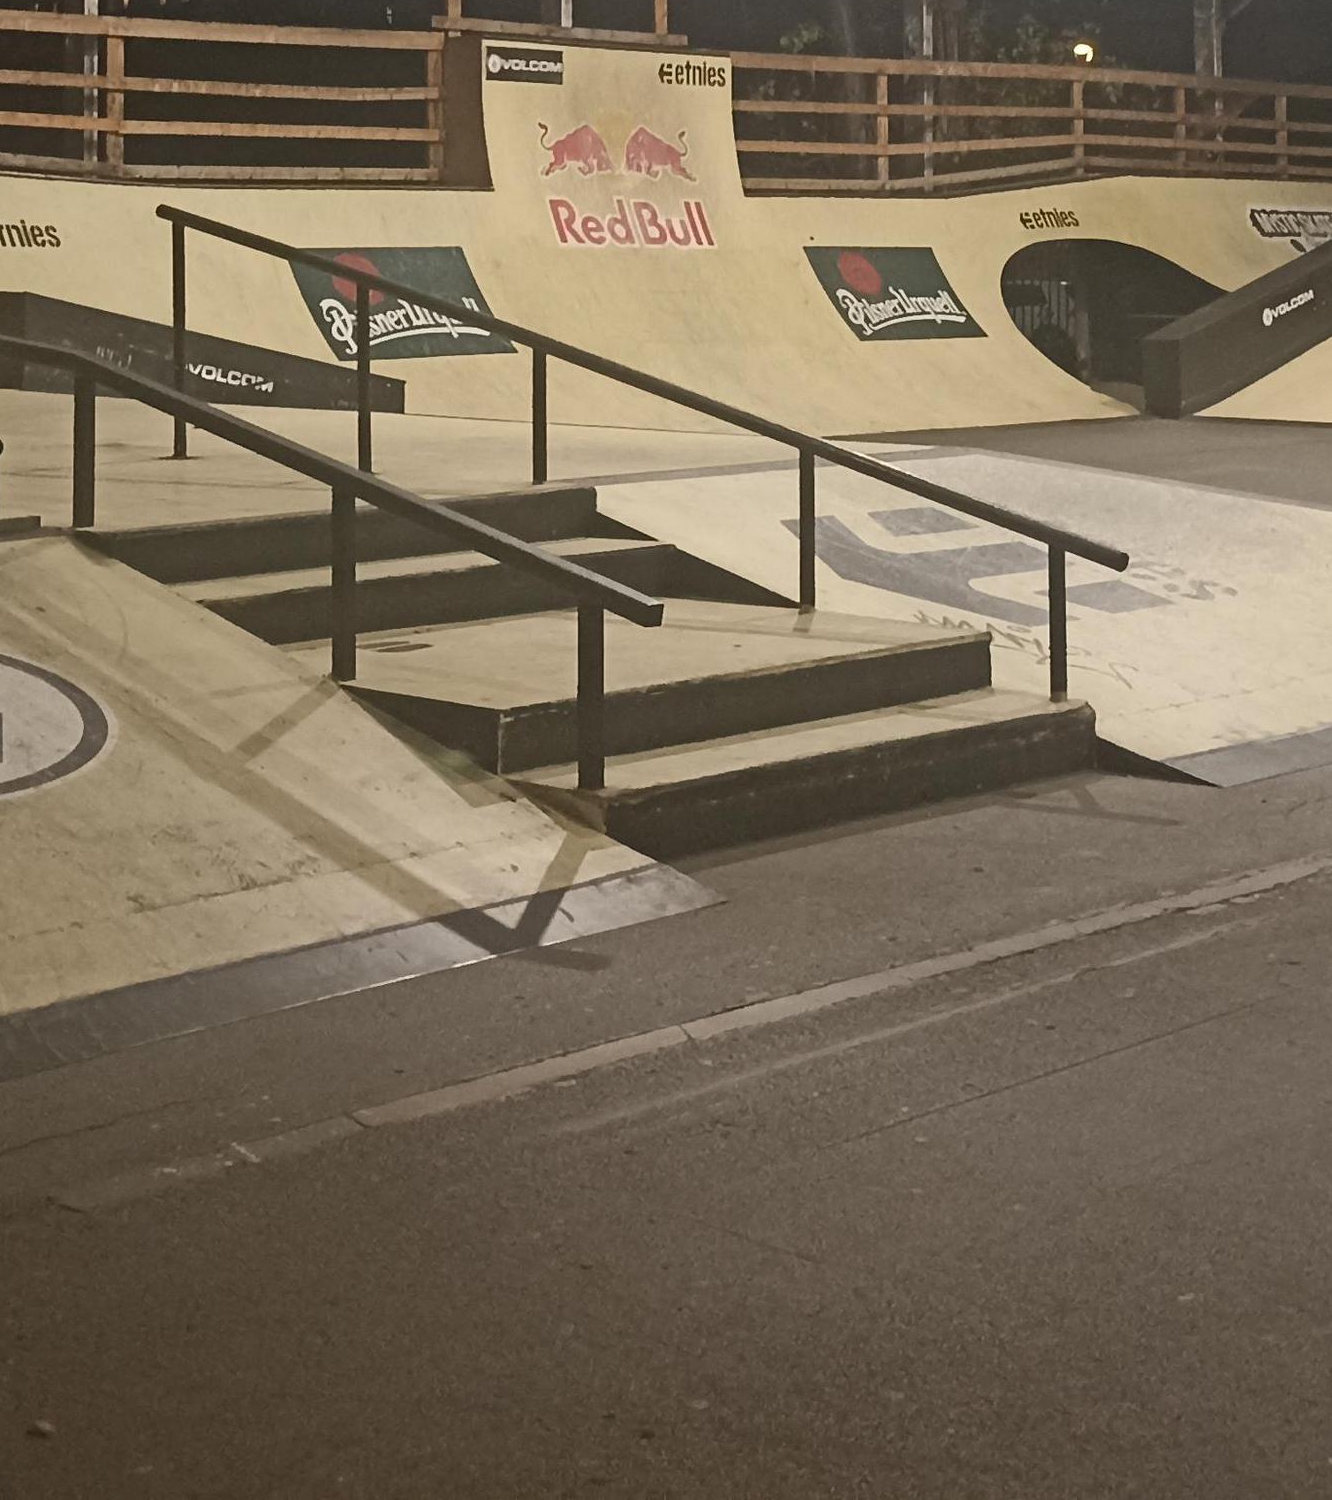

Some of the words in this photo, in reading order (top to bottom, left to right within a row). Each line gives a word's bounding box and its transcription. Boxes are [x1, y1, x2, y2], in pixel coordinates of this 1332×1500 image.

[501, 58, 563, 73] VOLCOM
[675, 61, 726, 87] etnies
[548, 198, 636, 246] Red
[633, 201, 716, 247] Bull
[1032, 207, 1080, 229] etnies
[1271, 289, 1314, 318] VOLCOM
